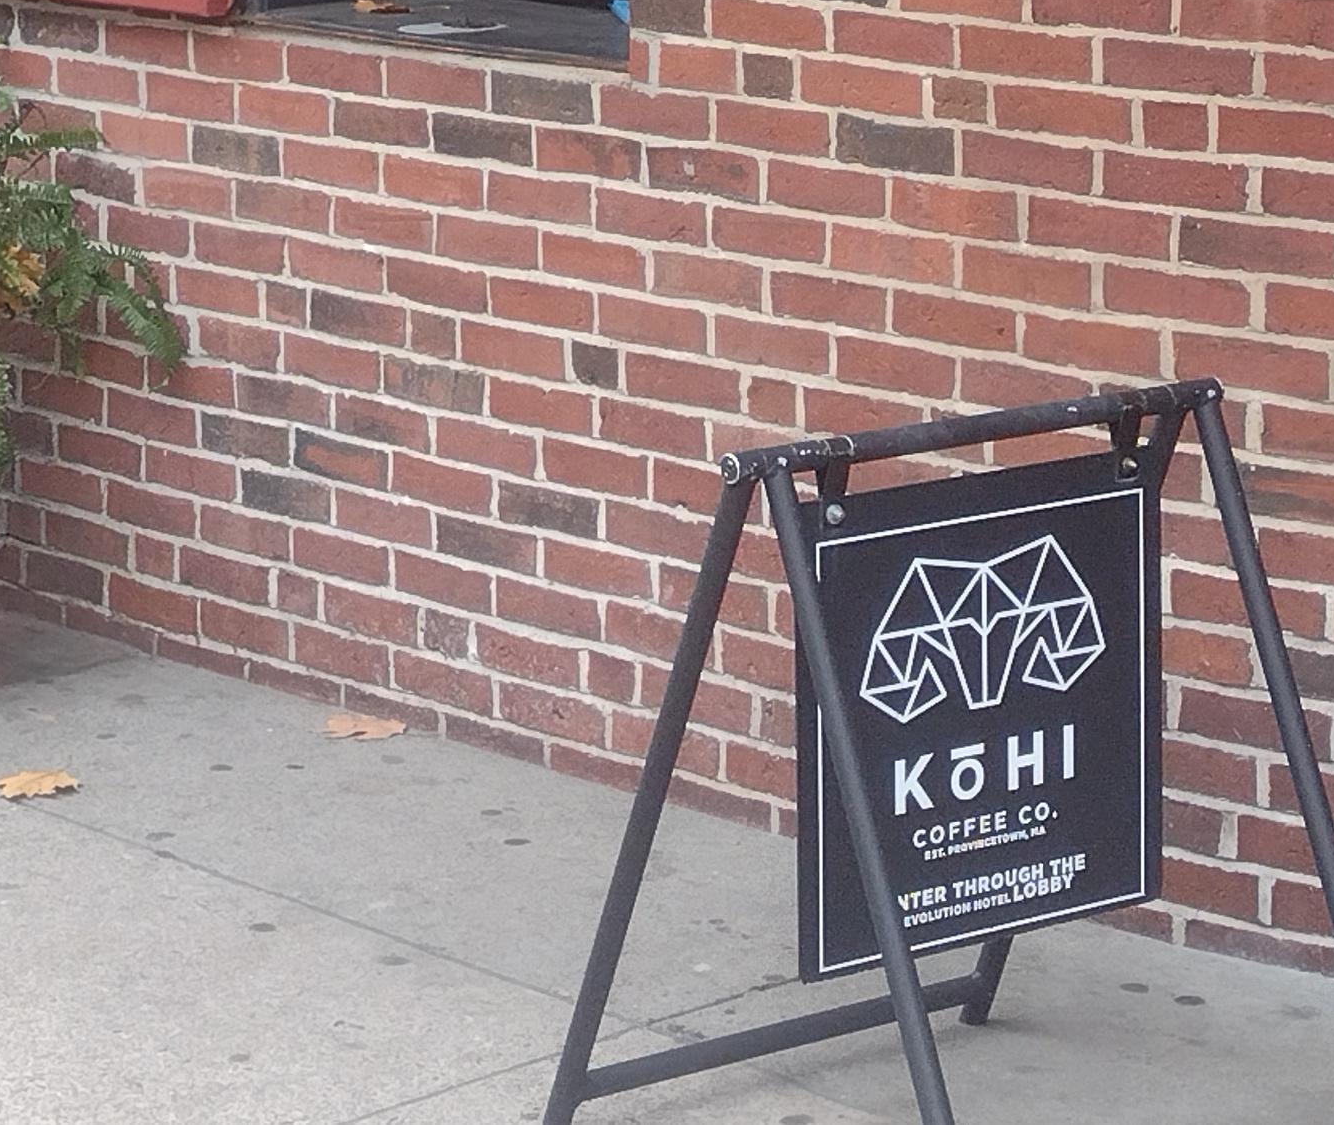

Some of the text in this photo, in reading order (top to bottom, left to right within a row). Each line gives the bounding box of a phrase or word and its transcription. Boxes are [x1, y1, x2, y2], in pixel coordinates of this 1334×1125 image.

[912, 801, 1058, 849] COFFEE CO.
[924, 825, 1046, 861] EST. PROVINCETOWN, MA
[898, 854, 1086, 911] NTER THROUGH THE
[903, 874, 1075, 928] EVOLUTION HOTEL LOBBY
